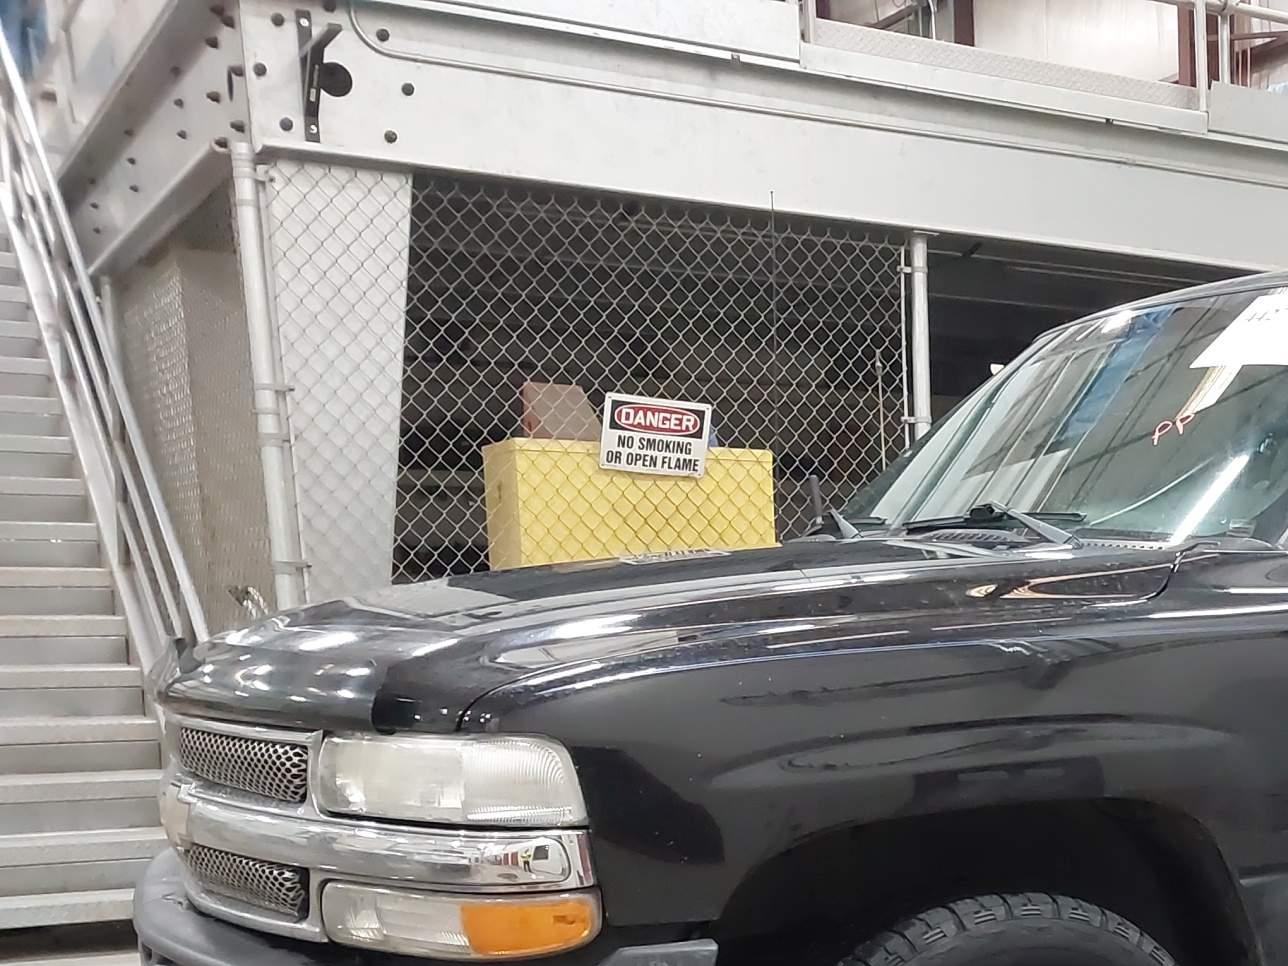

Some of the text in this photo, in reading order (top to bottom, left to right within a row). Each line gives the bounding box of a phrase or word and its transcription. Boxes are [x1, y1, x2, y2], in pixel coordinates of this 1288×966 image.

[620, 408, 695, 431] DANGER
[617, 434, 692, 455] NO SMOKING
[606, 450, 700, 472] OR OPEN FLAME
